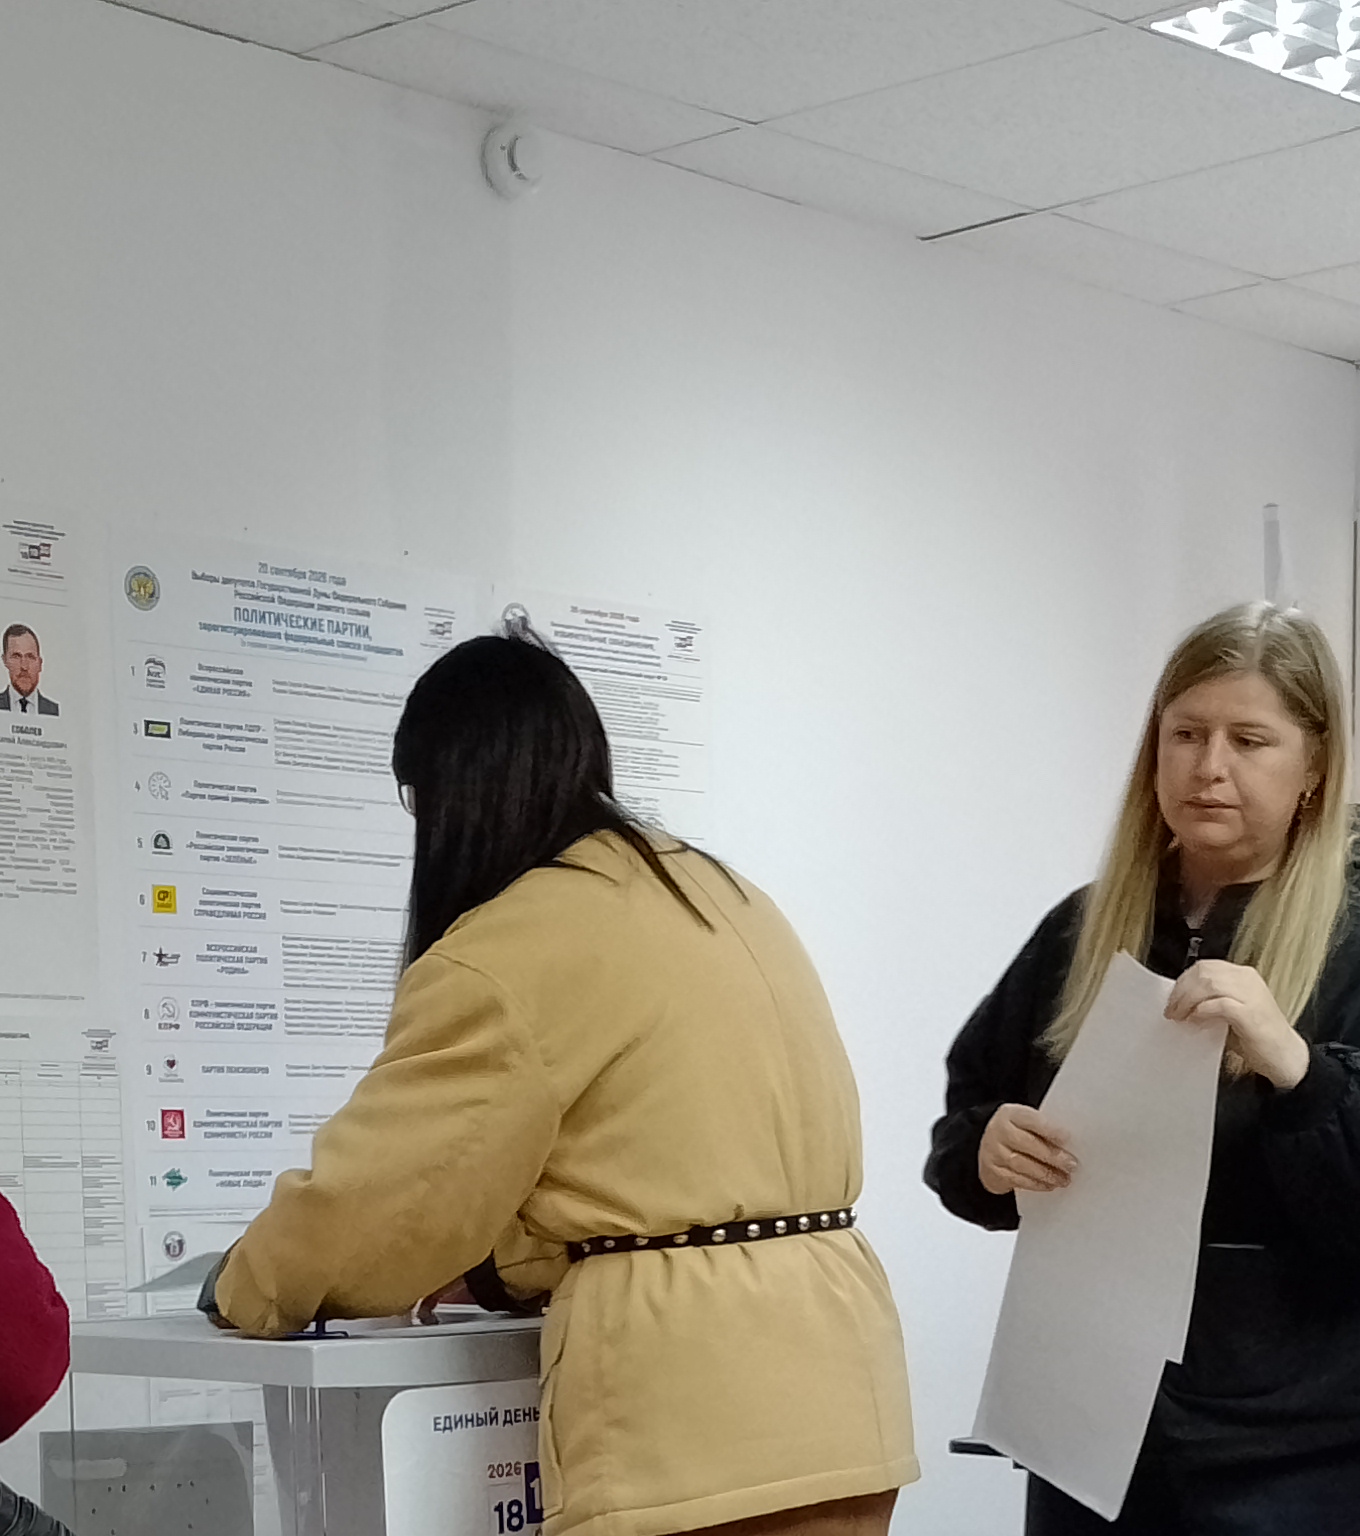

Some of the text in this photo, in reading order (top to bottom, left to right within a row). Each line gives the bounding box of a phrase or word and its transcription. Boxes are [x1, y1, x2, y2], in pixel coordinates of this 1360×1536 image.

[233, 606, 372, 641] ПОЛИТИЧЕСКИЕ ПАРТИИ,
[433, 1405, 541, 1433] ЕДИНЫЙ ДЕНЬ
[486, 1461, 522, 1480] 2026
[493, 1498, 524, 1535] 18
